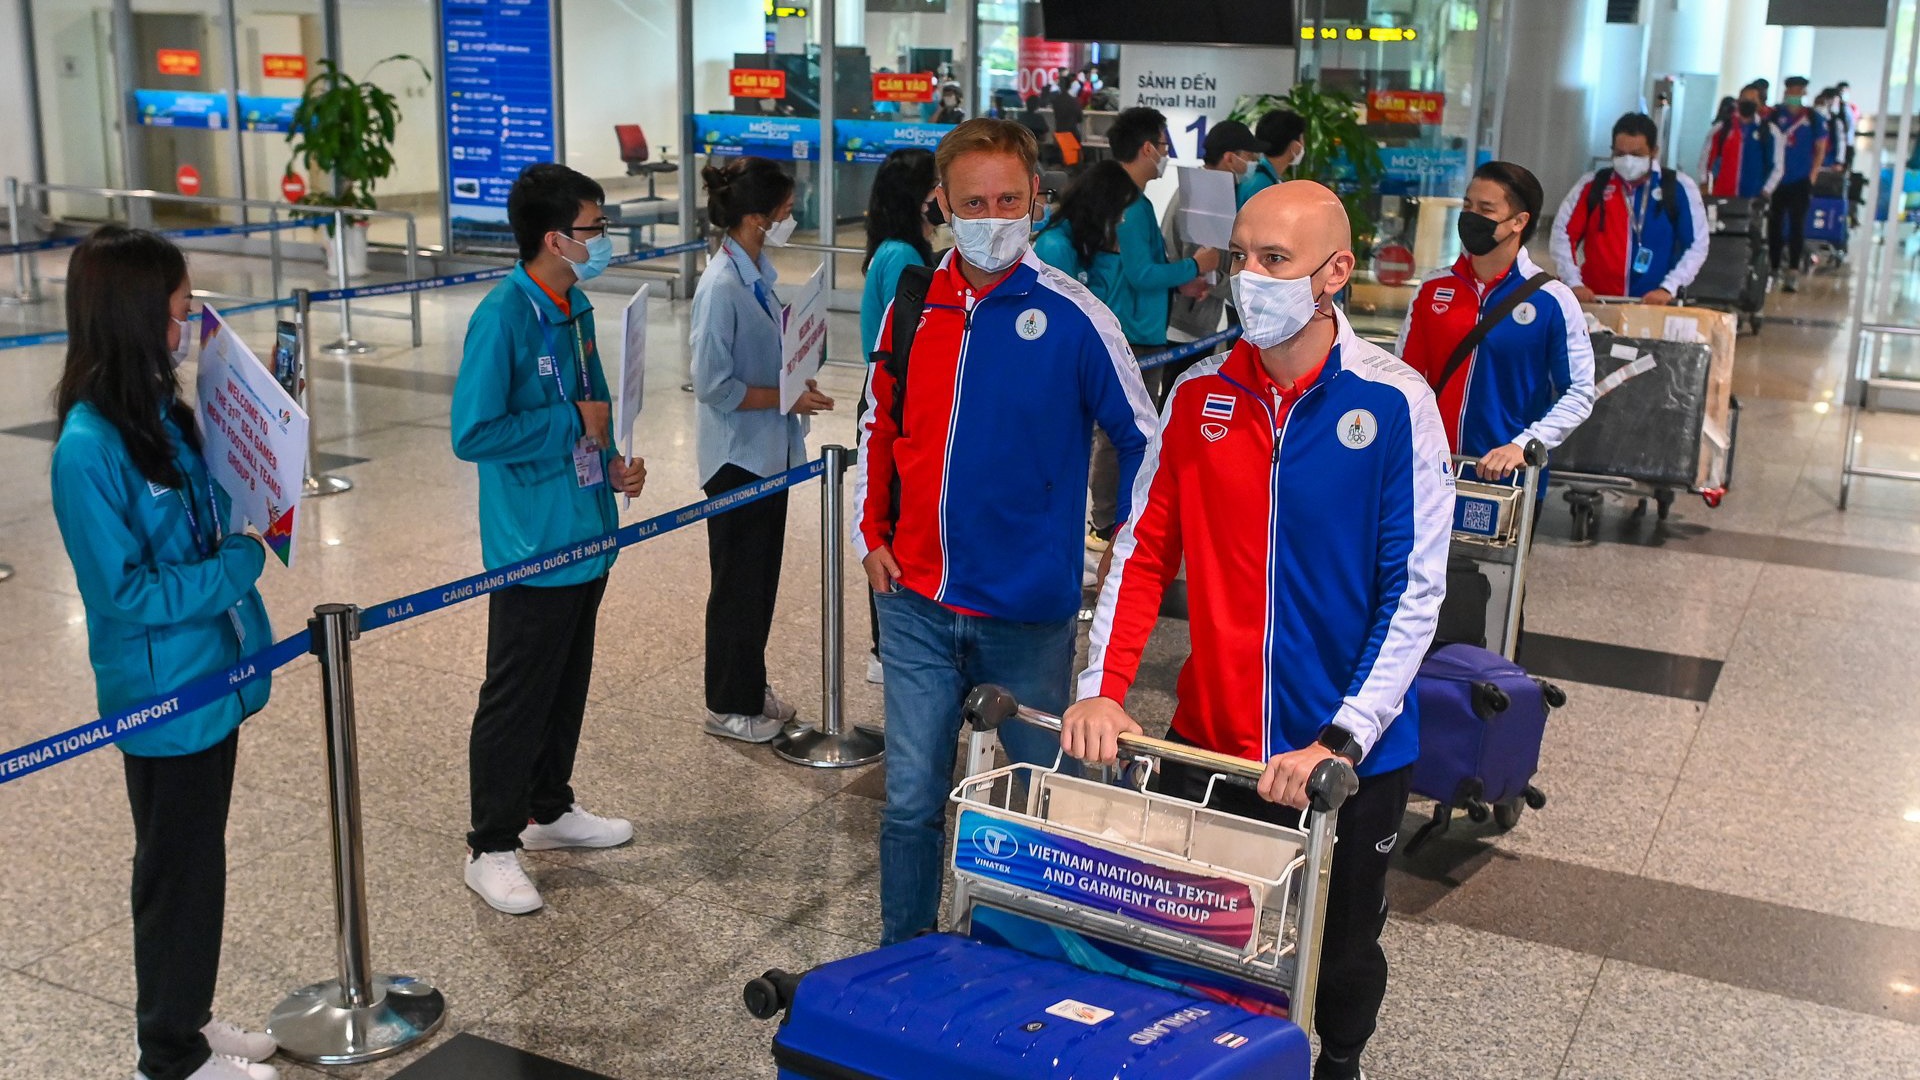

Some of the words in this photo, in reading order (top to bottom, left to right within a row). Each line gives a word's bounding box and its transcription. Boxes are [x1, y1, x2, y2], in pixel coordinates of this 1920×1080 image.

[1138, 70, 1176, 89] SẢNH
[1181, 72, 1216, 91] ĐẾN
[1138, 92, 1180, 107] Arrival
[1186, 95, 1216, 108] Hall
[227, 377, 259, 425] WELCOME
[259, 415, 269, 436] TO
[215, 387, 227, 411] THE
[241, 419, 254, 443] SEA
[254, 435, 277, 471] GAMES
[227, 426, 258, 473] FOOTBALL
[259, 463, 282, 500] TEAMS
[227, 449, 250, 482] GROUP
[703, 487, 759, 514] INTERNATIONAL
[759, 474, 788, 493] AIRPORT
[639, 522, 659, 537] N.I.A
[442, 585, 473, 603] CẢNG
[475, 576, 504, 592] HÀNG
[506, 563, 541, 583] KHÔNG
[543, 549, 570, 571] QUỐC
[571, 544, 583, 561] TẾ
[584, 541, 601, 557] NỘI
[602, 535, 617, 551] BÀI
[387, 603, 414, 620] N.I.A
[229, 664, 257, 685] N.I.A
[117, 696, 181, 735] AIRPORT
[974, 856, 1011, 875] VINATEX
[1028, 842, 1094, 874] VIETNAM
[1097, 861, 1174, 896] NATIONAL
[1177, 884, 1239, 913] TEXTILE
[1042, 866, 1076, 887] AND
[1078, 876, 1152, 907] GARMENT
[1155, 898, 1211, 924] GROUP
[1128, 1007, 1212, 1046] THAILAND
